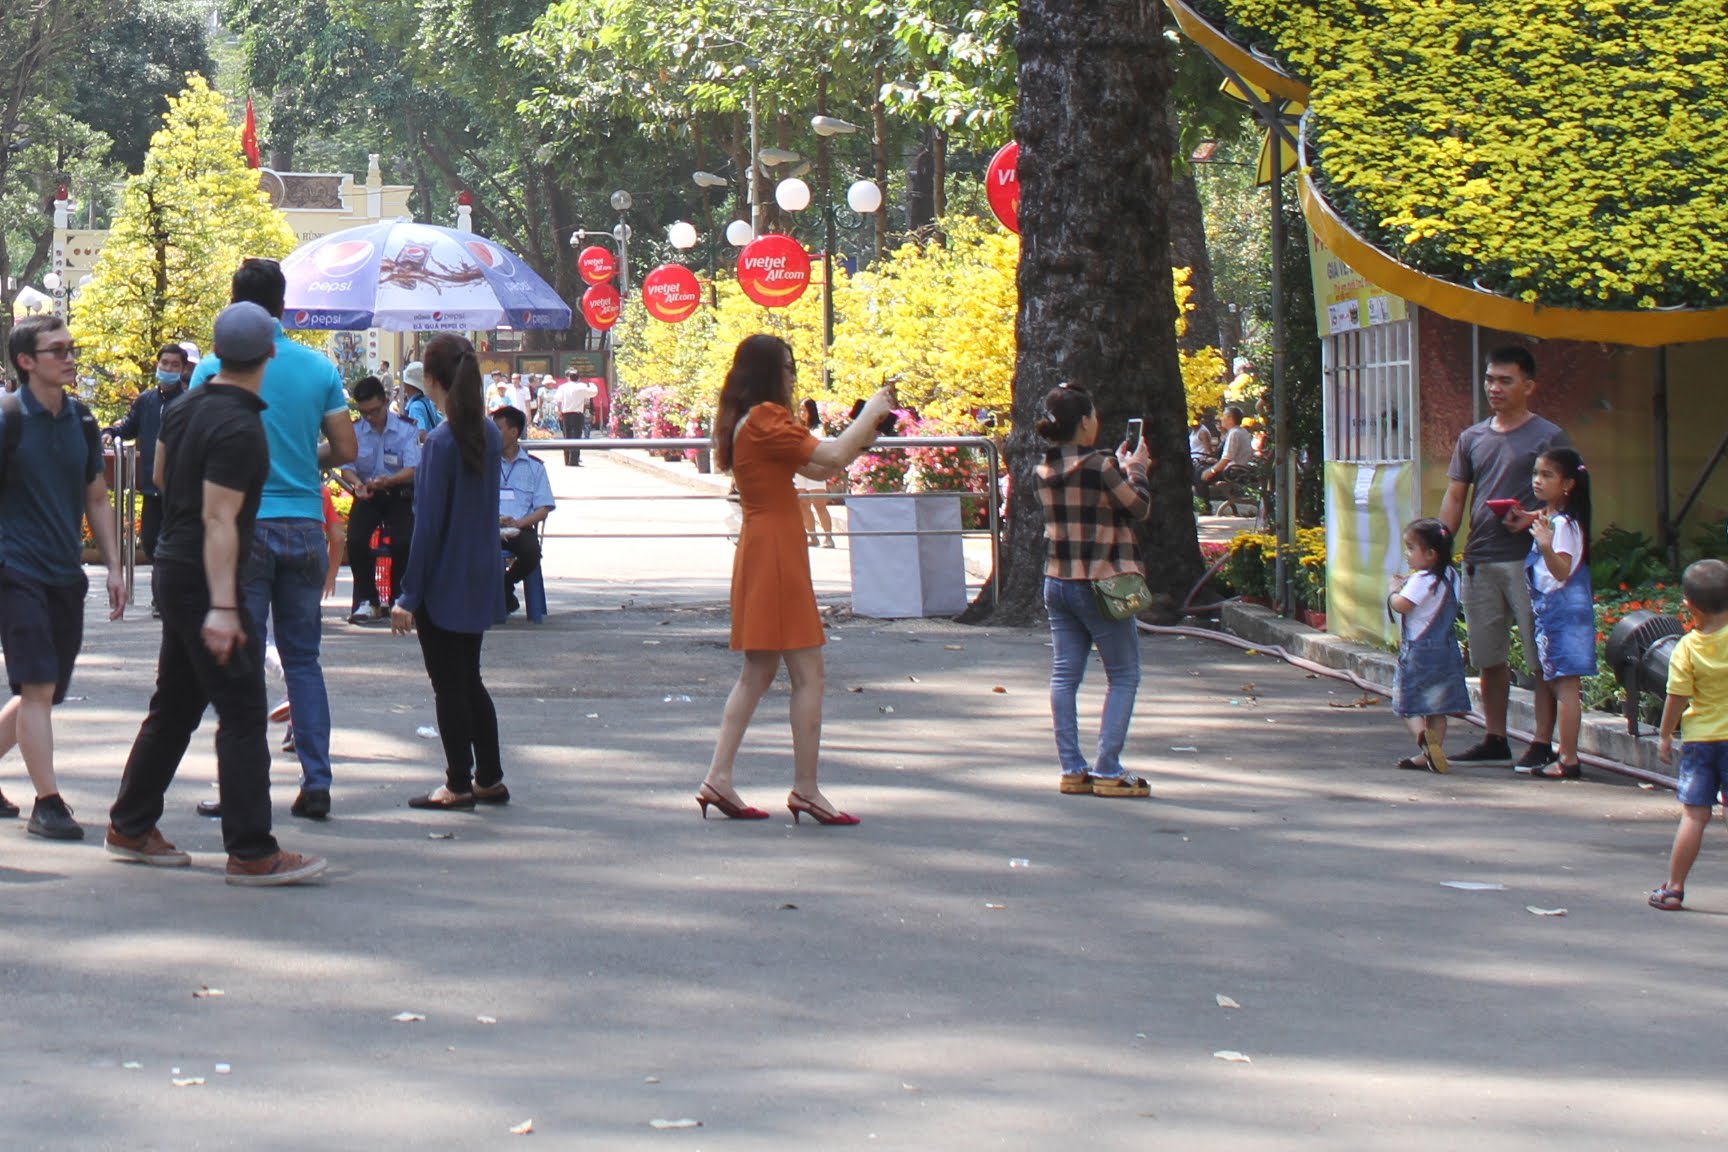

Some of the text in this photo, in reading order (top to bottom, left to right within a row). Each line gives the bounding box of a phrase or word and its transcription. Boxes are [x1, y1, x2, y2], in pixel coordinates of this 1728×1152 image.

[765, 269, 805, 281] Air.com
[307, 280, 353, 293] pepsi
[664, 293, 696, 303] Air.com
[311, 314, 341, 326] pepsi
